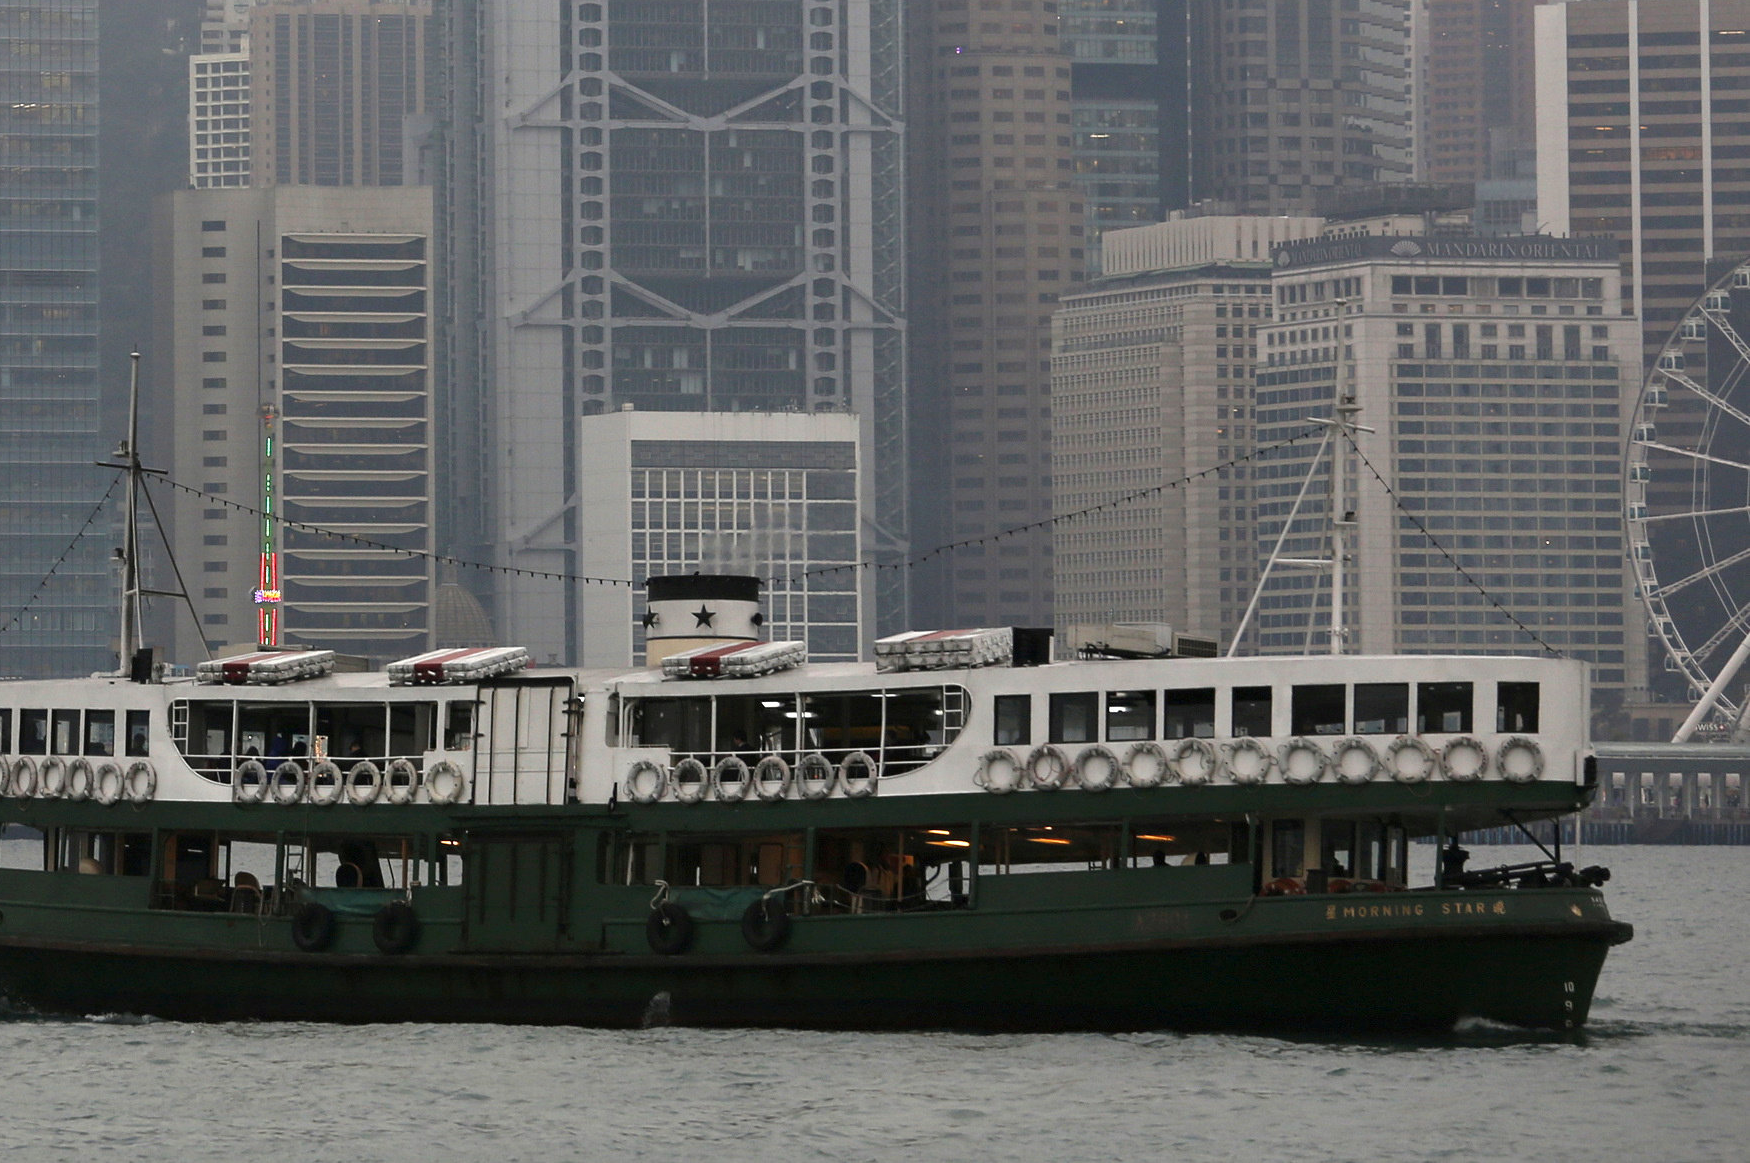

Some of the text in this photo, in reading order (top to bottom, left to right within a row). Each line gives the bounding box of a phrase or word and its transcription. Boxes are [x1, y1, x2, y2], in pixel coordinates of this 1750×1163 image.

[1427, 242, 1516, 257] MANDARIN
[1343, 903, 1425, 918] MORNING
[1442, 901, 1486, 915] STAR
[1564, 981, 1575, 993] 10
